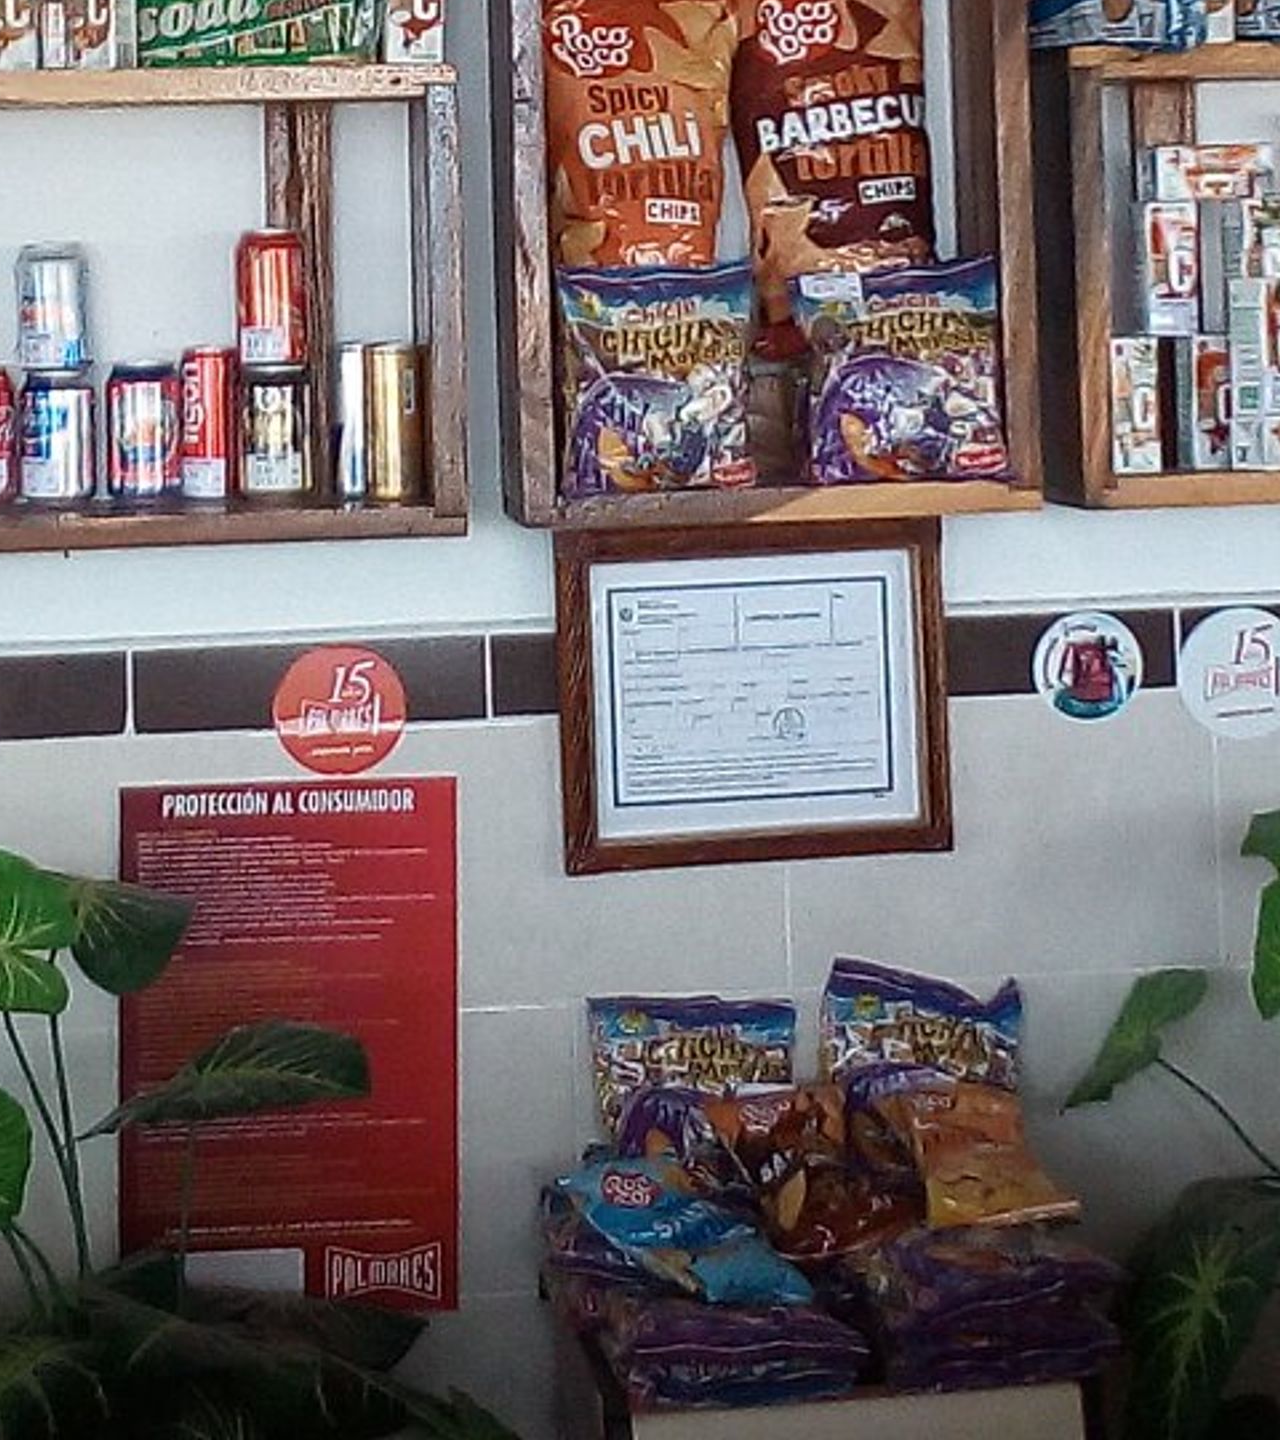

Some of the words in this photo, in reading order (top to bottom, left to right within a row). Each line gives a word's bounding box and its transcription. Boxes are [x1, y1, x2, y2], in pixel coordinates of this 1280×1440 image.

[861, 179, 916, 201] CHIPS
[647, 201, 700, 222] CHIPS
[1235, 624, 1274, 665] 15
[328, 661, 375, 703] 15
[163, 787, 267, 818] PROTECCIÓN
[272, 793, 295, 815] AL
[299, 788, 414, 814] CONSUMIDOR
